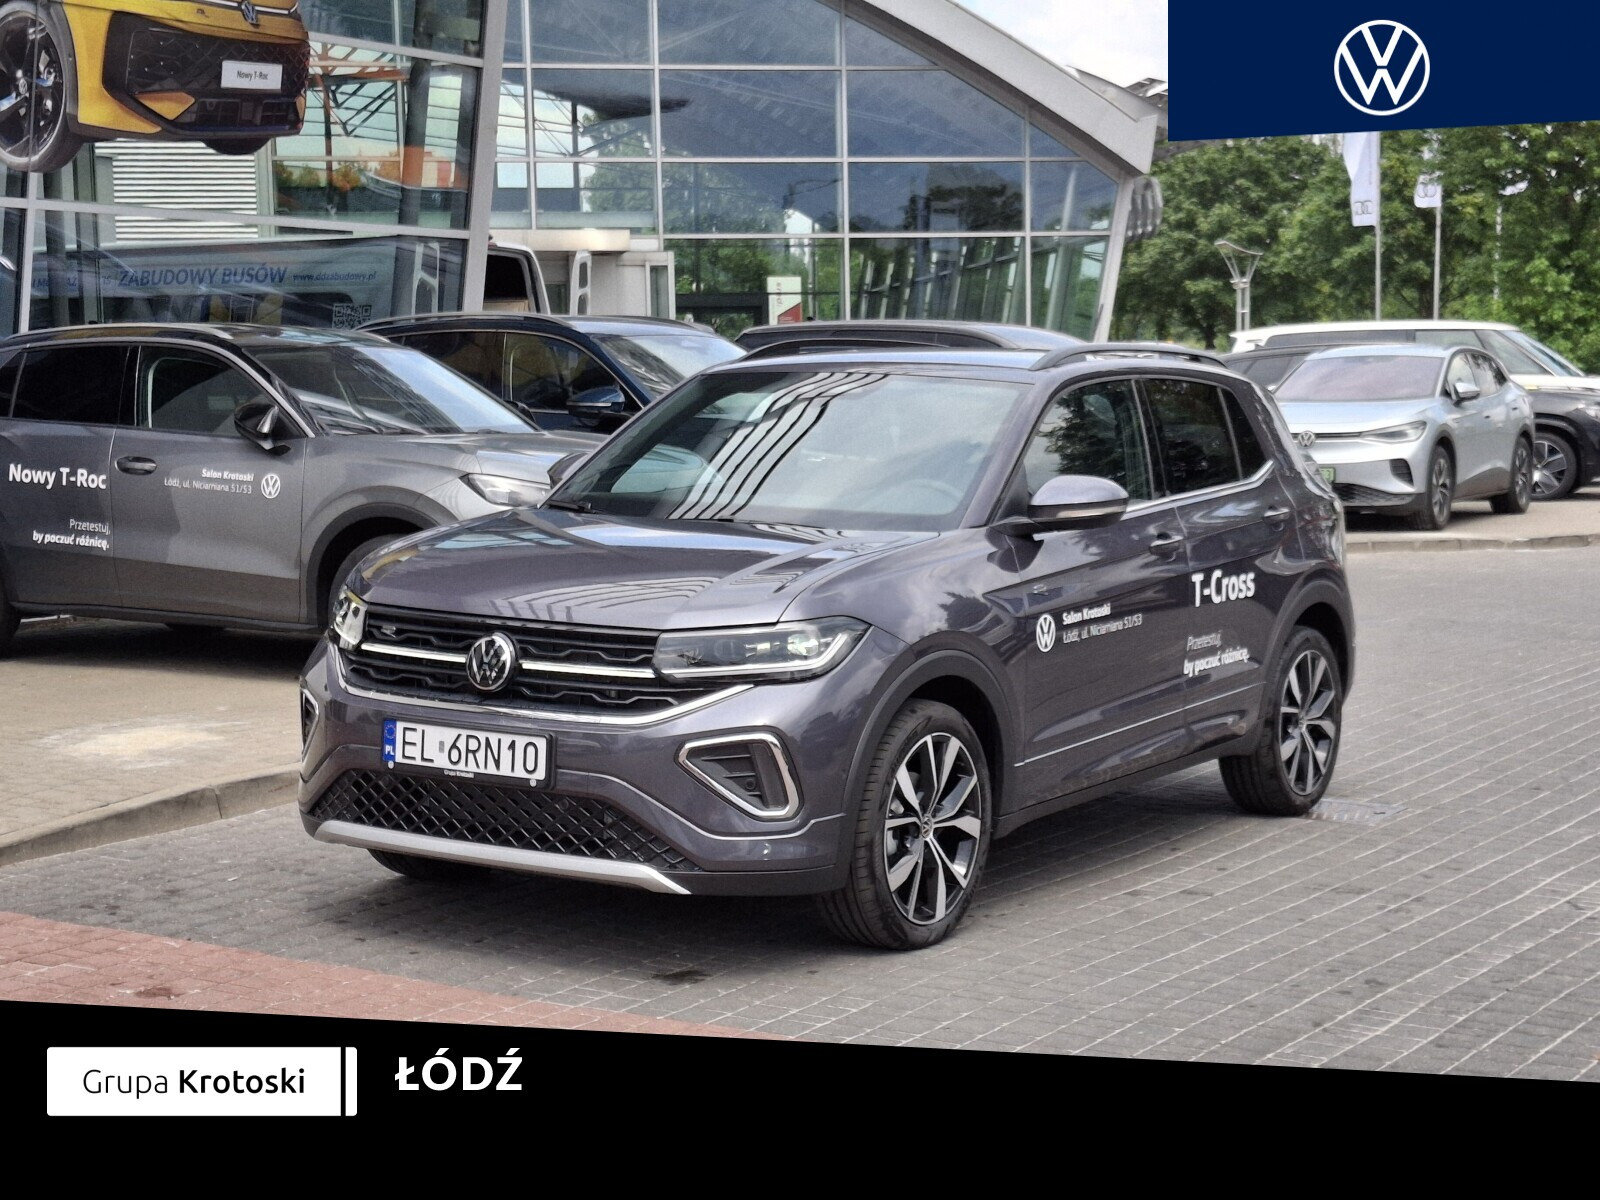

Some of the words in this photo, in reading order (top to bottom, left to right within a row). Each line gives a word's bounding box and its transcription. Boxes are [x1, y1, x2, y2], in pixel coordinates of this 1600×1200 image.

[236, 70, 253, 81] Nowy
[254, 71, 268, 80] T-Roc
[118, 268, 217, 287] ZABUDOWY
[221, 263, 288, 285] BUSÓW
[293, 271, 377, 282] www.ddzabudowy.pl
[8, 463, 56, 489] Nowy
[60, 466, 107, 489] T-Roc
[202, 468, 222, 480] Salon
[223, 470, 254, 482] Krotoski
[230, 483, 252, 494] 51/53
[69, 518, 111, 535] Przetestuj,
[32, 530, 44, 544] by
[44, 533, 75, 547] poczuć
[75, 535, 110, 551] różnicę.
[1191, 568, 1256, 608] T-Cross
[1062, 609, 1082, 625] Salon
[1083, 602, 1111, 621] Krotoski
[1123, 612, 1143, 630] 51/53
[1186, 630, 1223, 652] Przetestuj,
[1183, 657, 1194, 678] by
[1194, 656, 1221, 675] poczuć
[1221, 647, 1250, 665] różnicę.
[385, 744, 395, 756] PL
[401, 726, 435, 764] EL
[447, 733, 539, 775] 6RN10
